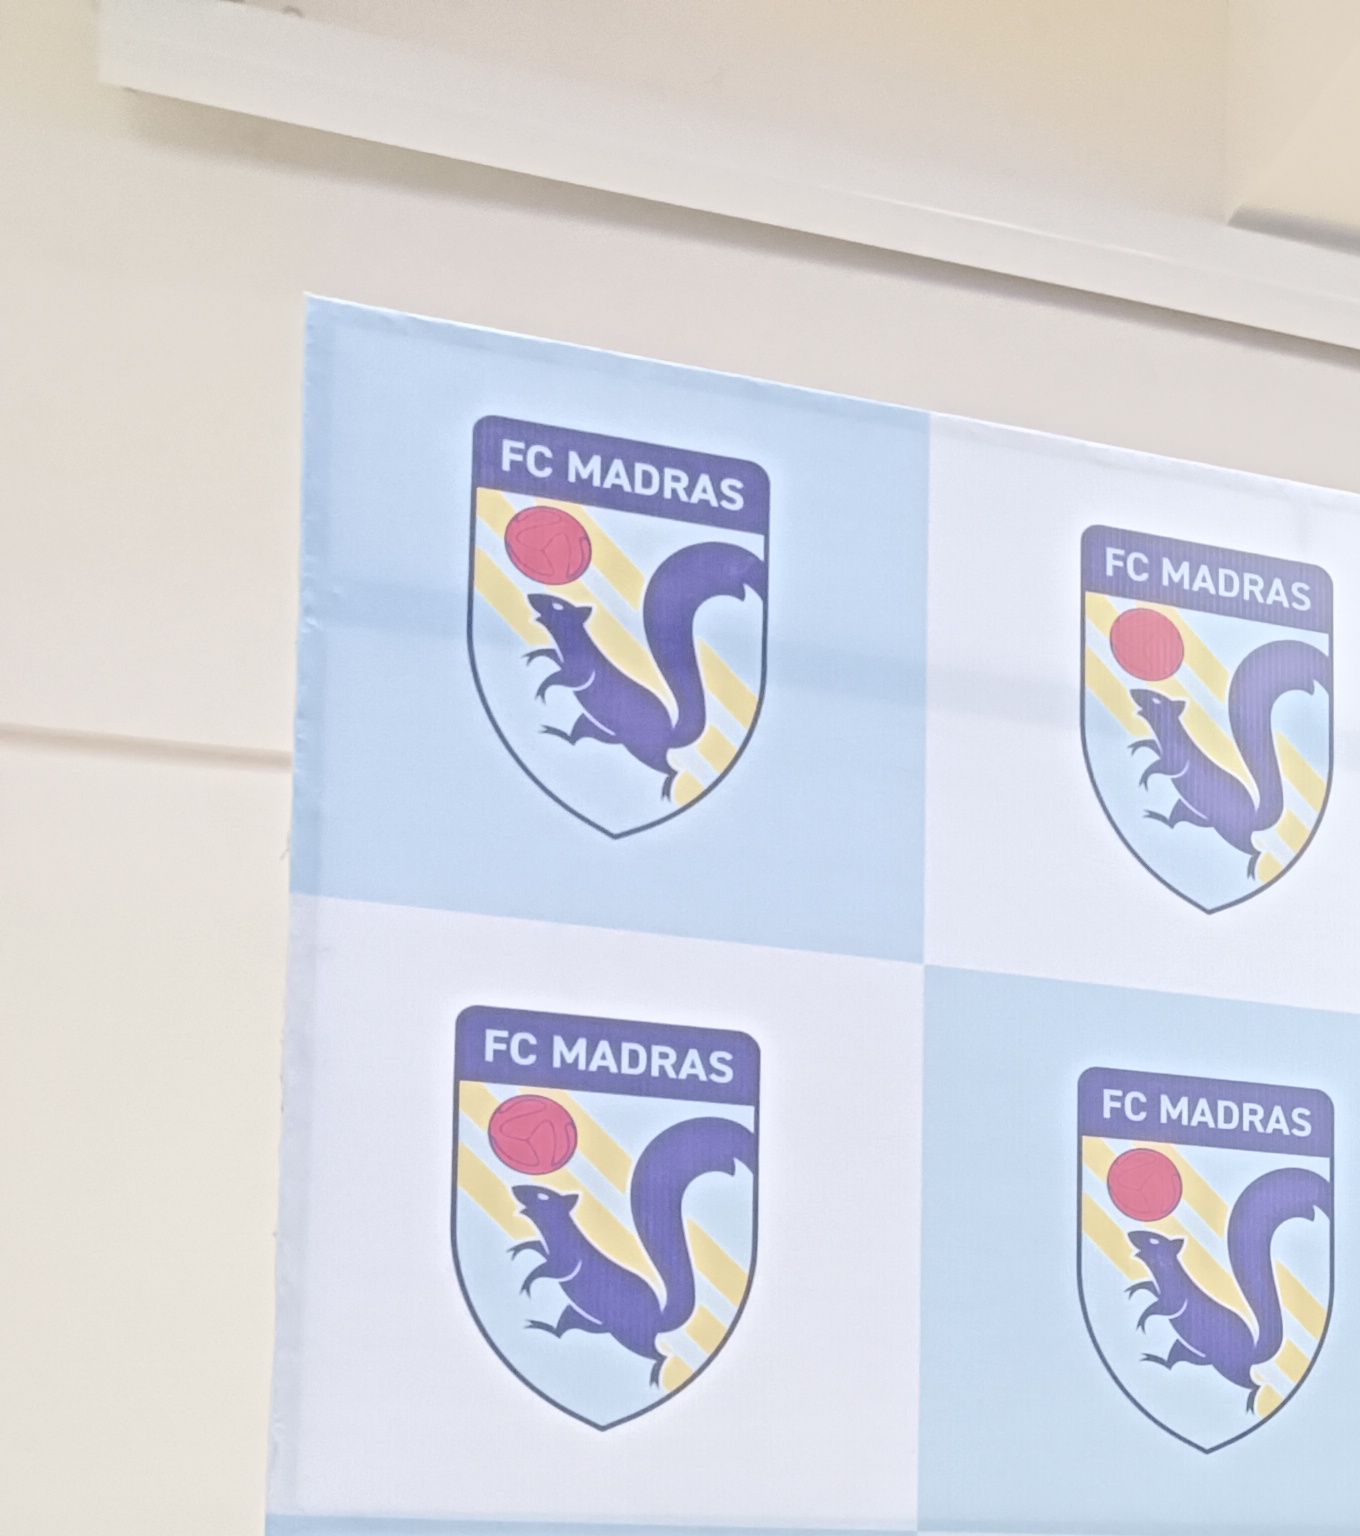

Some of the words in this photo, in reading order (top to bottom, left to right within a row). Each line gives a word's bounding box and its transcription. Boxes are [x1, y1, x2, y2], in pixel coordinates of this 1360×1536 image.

[501, 438, 553, 478] FC
[567, 450, 745, 511] MADRAS
[1106, 547, 1149, 582] FC
[1162, 557, 1311, 611] MADRAS
[484, 1028, 538, 1066] FC
[552, 1035, 734, 1084] MADRAS
[1102, 1088, 1147, 1122] FC
[1160, 1094, 1312, 1137] MADRAS
